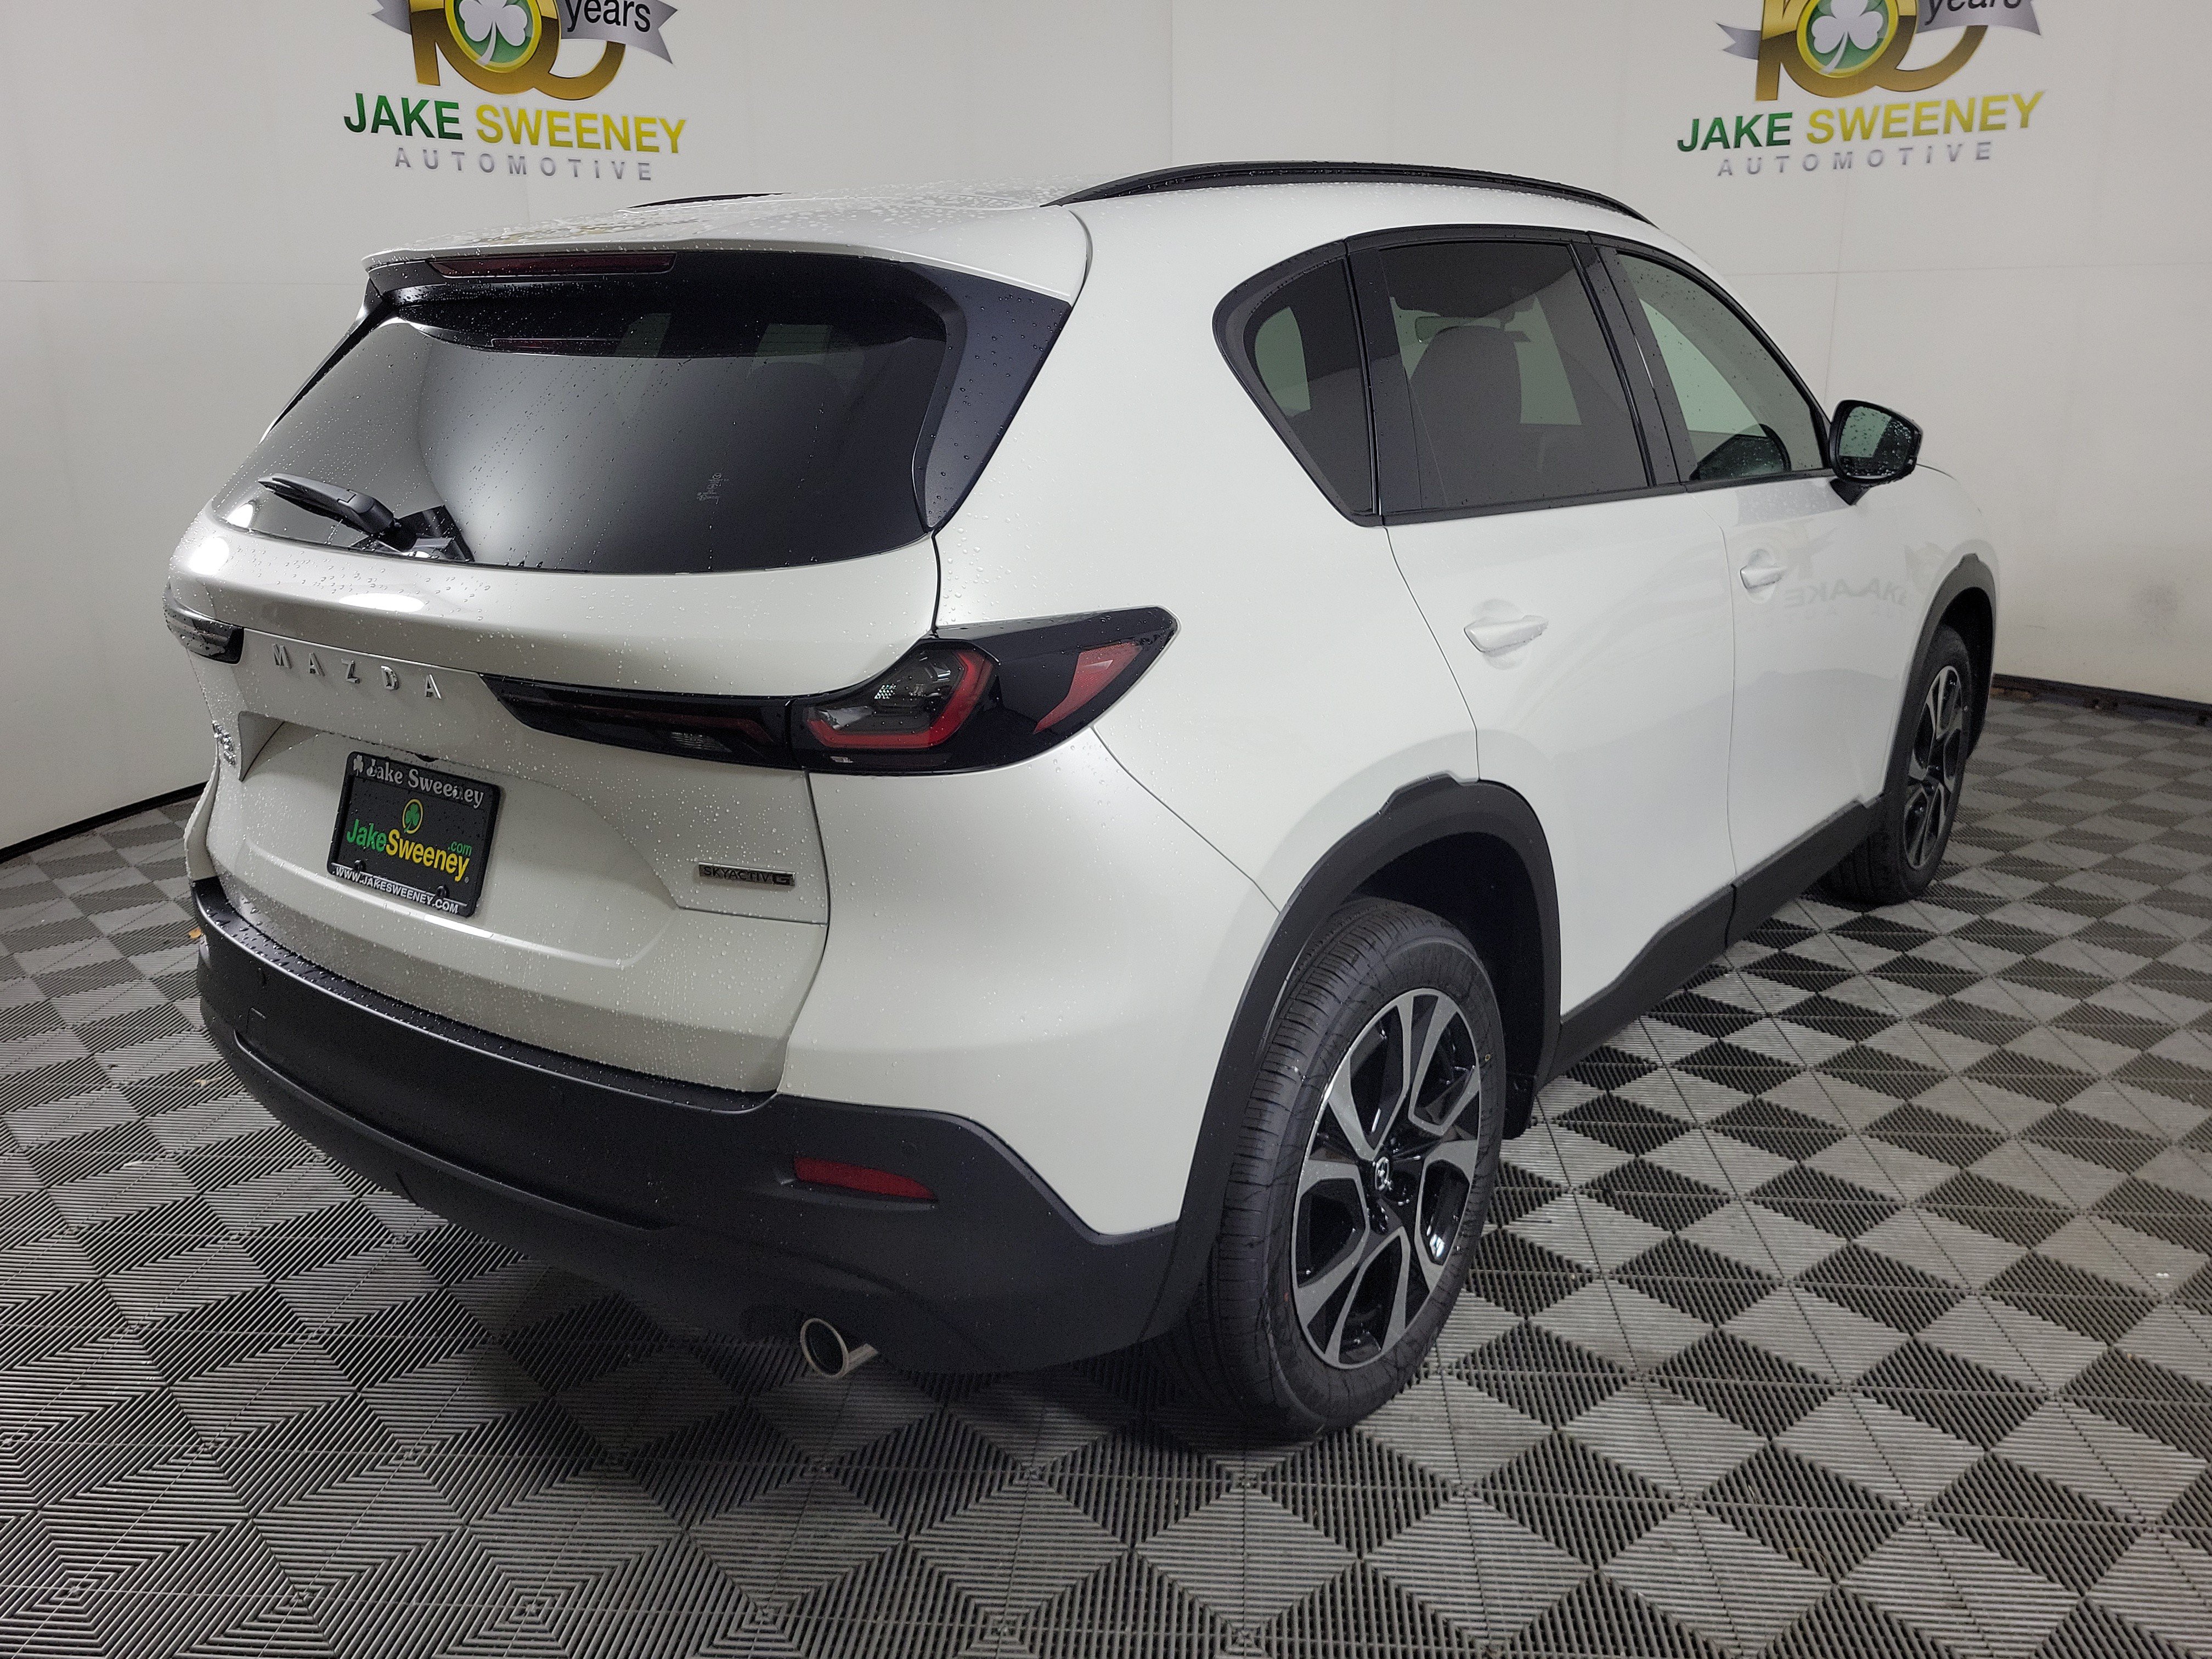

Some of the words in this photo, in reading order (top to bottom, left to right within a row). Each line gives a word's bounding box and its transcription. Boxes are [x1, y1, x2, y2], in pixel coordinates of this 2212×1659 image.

[567, 0, 651, 32] years
[343, 92, 462, 140] JAKE
[476, 104, 686, 154] SWEENEY
[1677, 112, 1793, 152] JAKE
[1806, 91, 2045, 144] SWEENEY
[395, 148, 652, 181] AUTOMOTIVE
[1717, 142, 1991, 177] AUTOMOTIVE
[272, 643, 442, 699] MAZDA
[366, 758, 403, 785] Jake
[408, 769, 484, 809] Sweeney
[346, 819, 470, 882] JakeSweeney
[335, 866, 459, 914] WWW.JAKESWEENEY.COM
